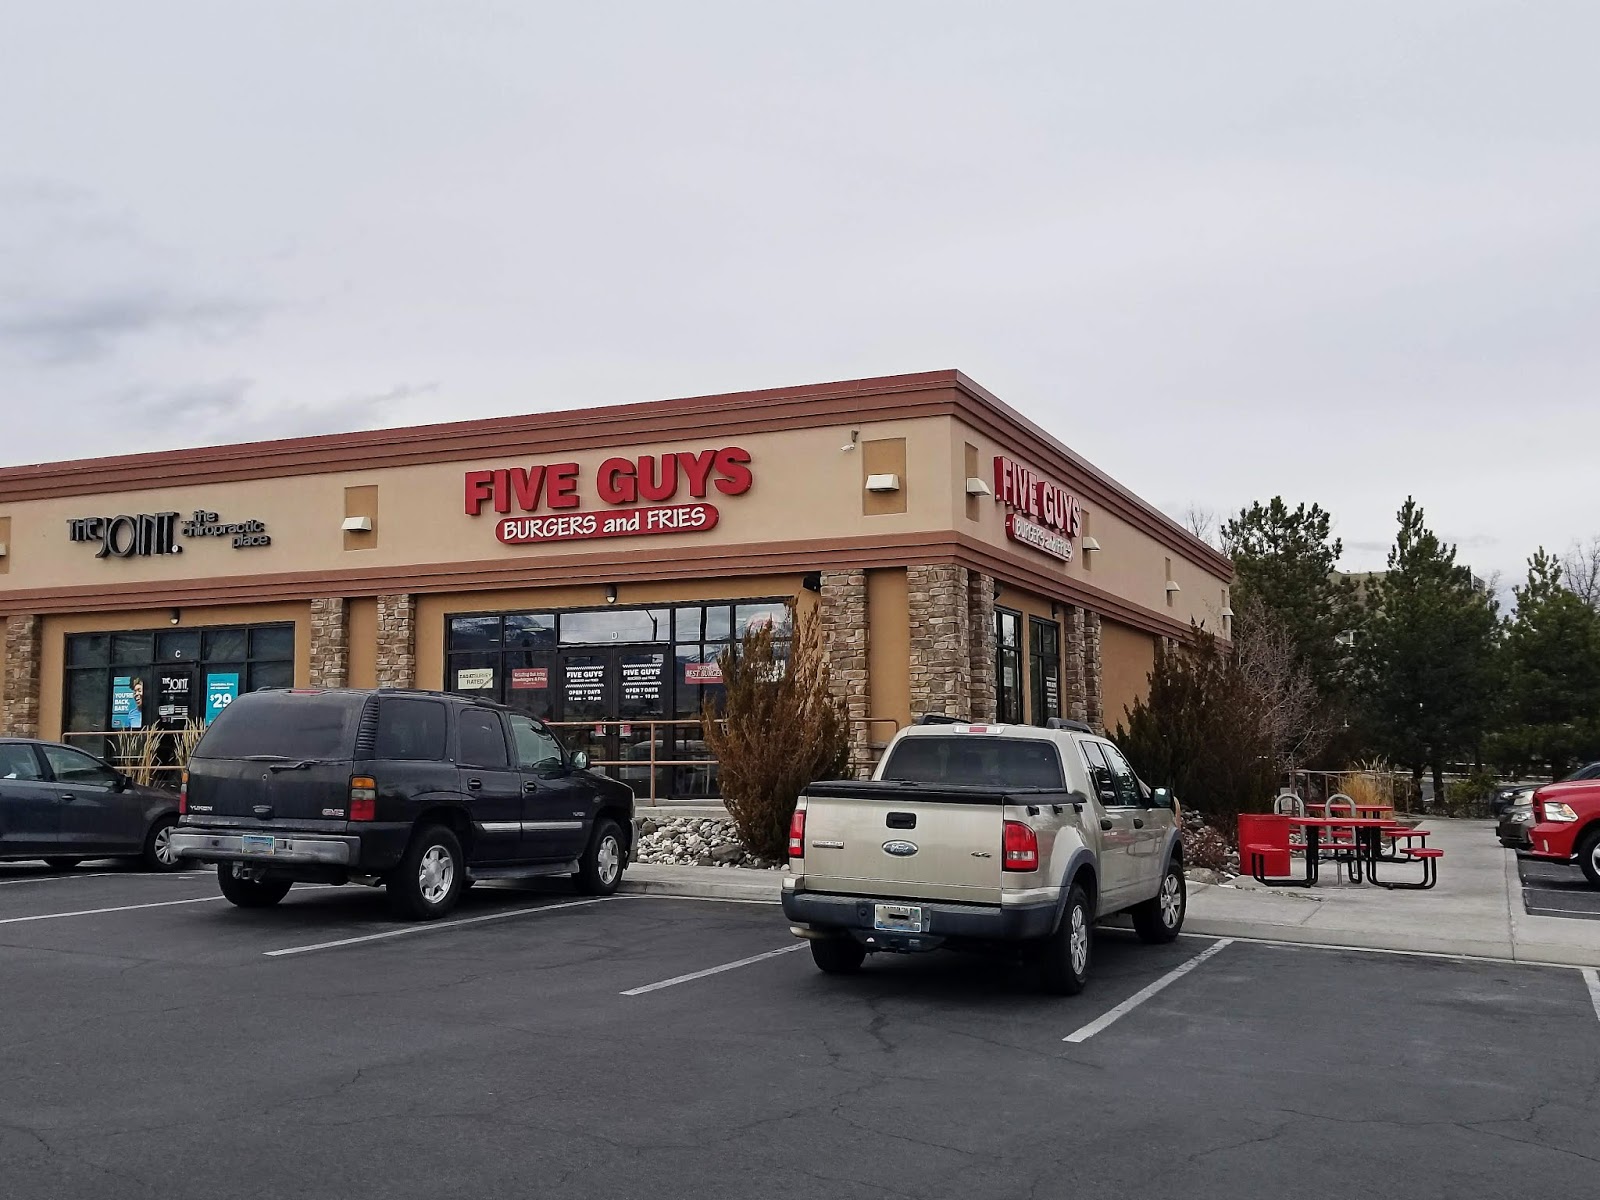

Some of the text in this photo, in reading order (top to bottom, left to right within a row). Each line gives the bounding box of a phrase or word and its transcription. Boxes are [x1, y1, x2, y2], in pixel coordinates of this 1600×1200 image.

[465, 446, 753, 516] FIVE GUYS
[994, 456, 1080, 538] FIVE GUYS
[66, 518, 102, 541] THE
[182, 519, 265, 537] chiropractic
[503, 507, 706, 540] BURGERS and FRIES
[232, 534, 271, 549] place
[612, 632, 618, 640] D
[175, 650, 181, 658] C
[583, 670, 603, 678] GUYS
[210, 693, 232, 708] $29
[322, 808, 345, 816] GMC
